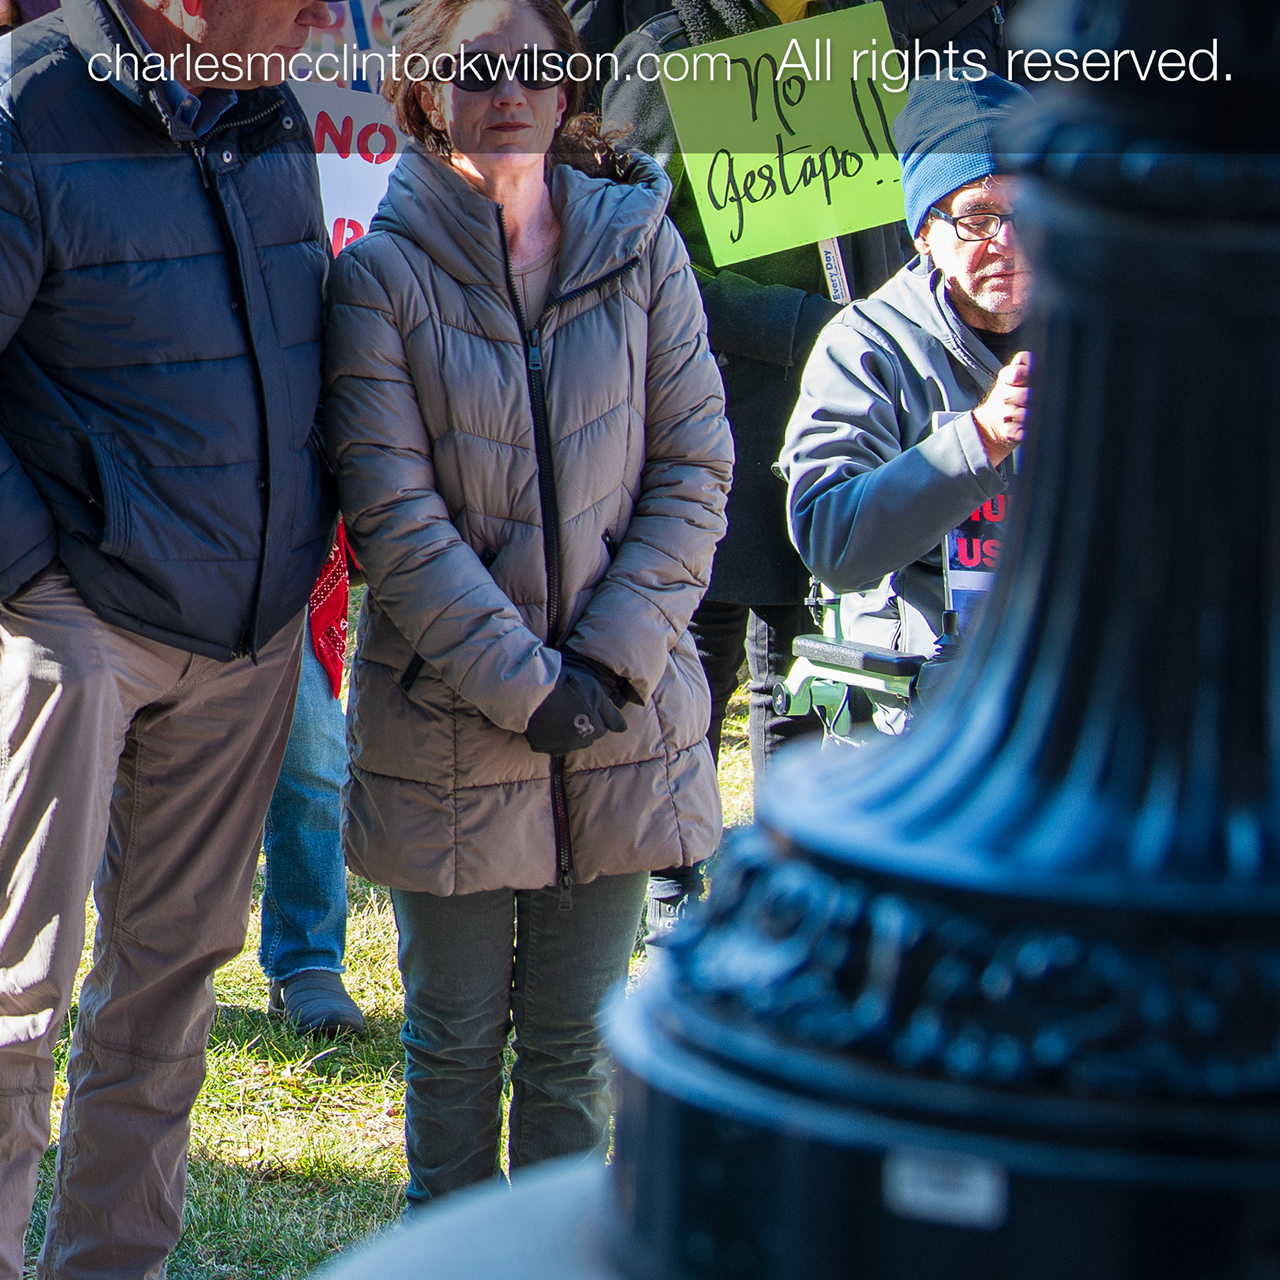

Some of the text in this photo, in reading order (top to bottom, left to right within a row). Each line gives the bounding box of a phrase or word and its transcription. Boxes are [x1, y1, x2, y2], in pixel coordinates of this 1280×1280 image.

[314, 110, 397, 164] NO
[824, 250, 834, 270] Day
[829, 272, 841, 300] Every
